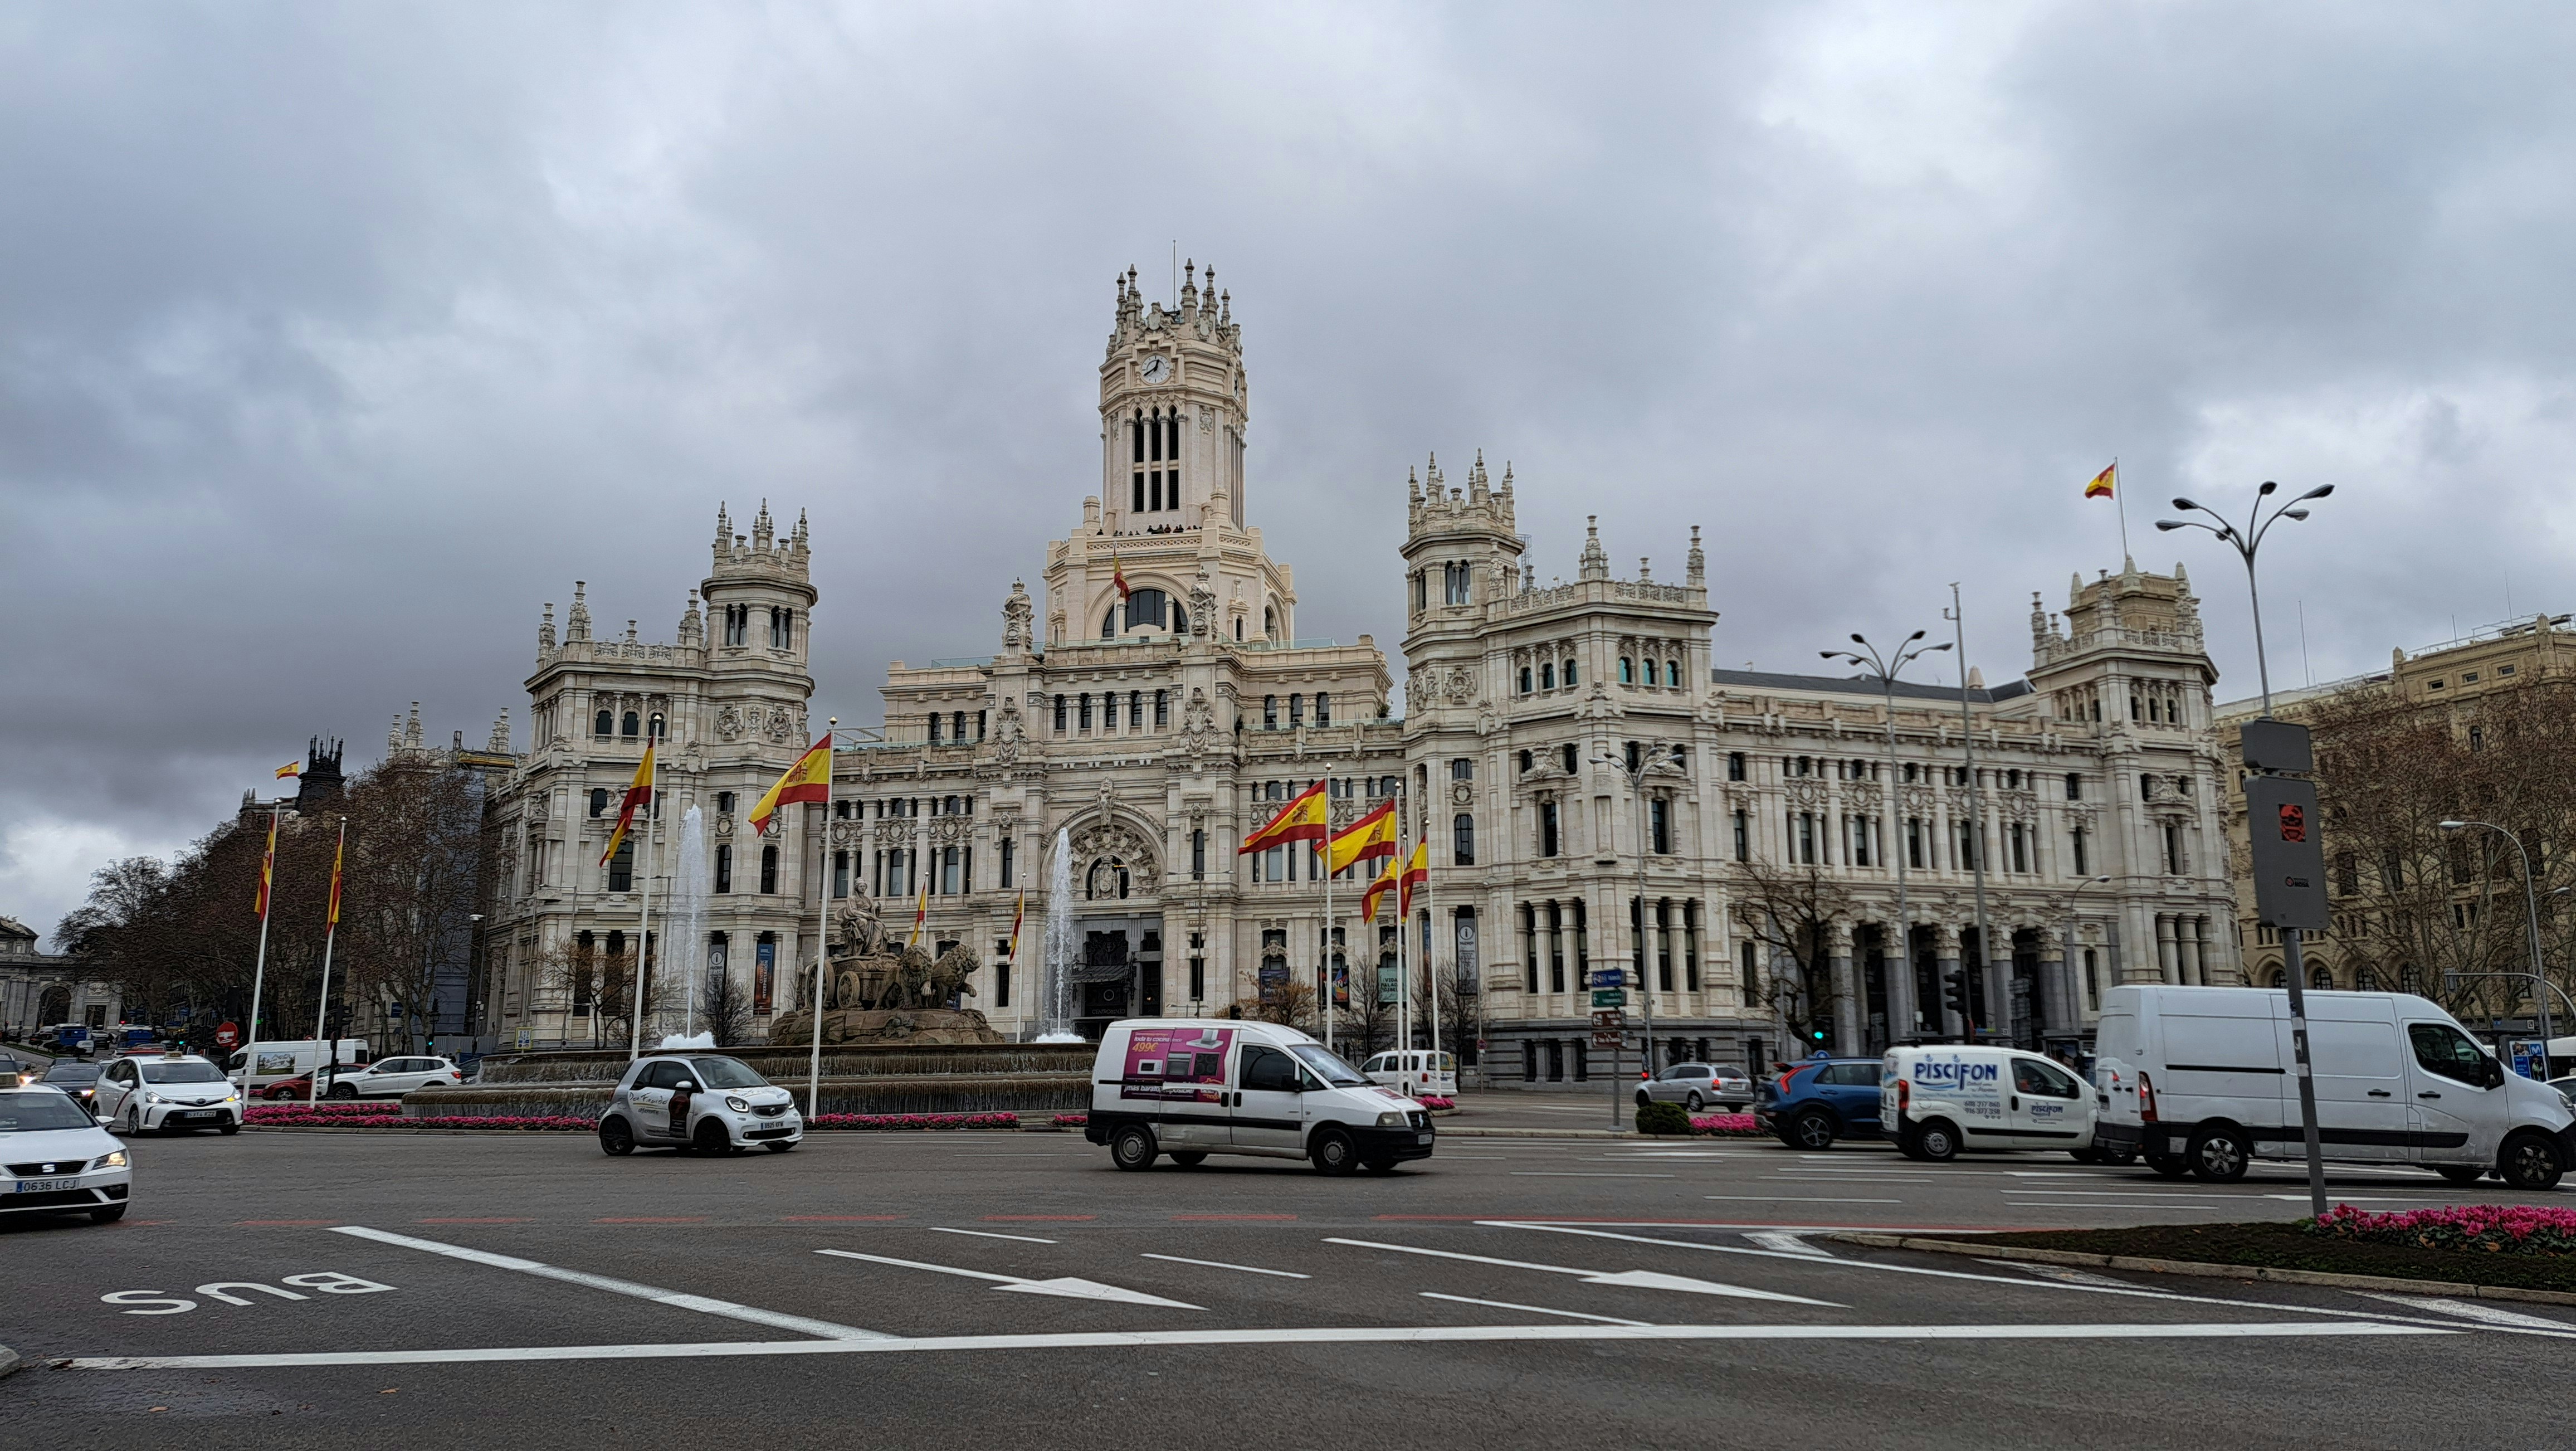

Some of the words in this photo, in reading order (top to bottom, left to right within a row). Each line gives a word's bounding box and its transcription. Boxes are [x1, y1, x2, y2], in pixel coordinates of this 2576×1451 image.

[1132, 1042, 1159, 1053] 499€
[23, 1182, 52, 1191] 0636
[56, 1180, 76, 1190] LCJ
[100, 1272, 399, 1314] BUS
